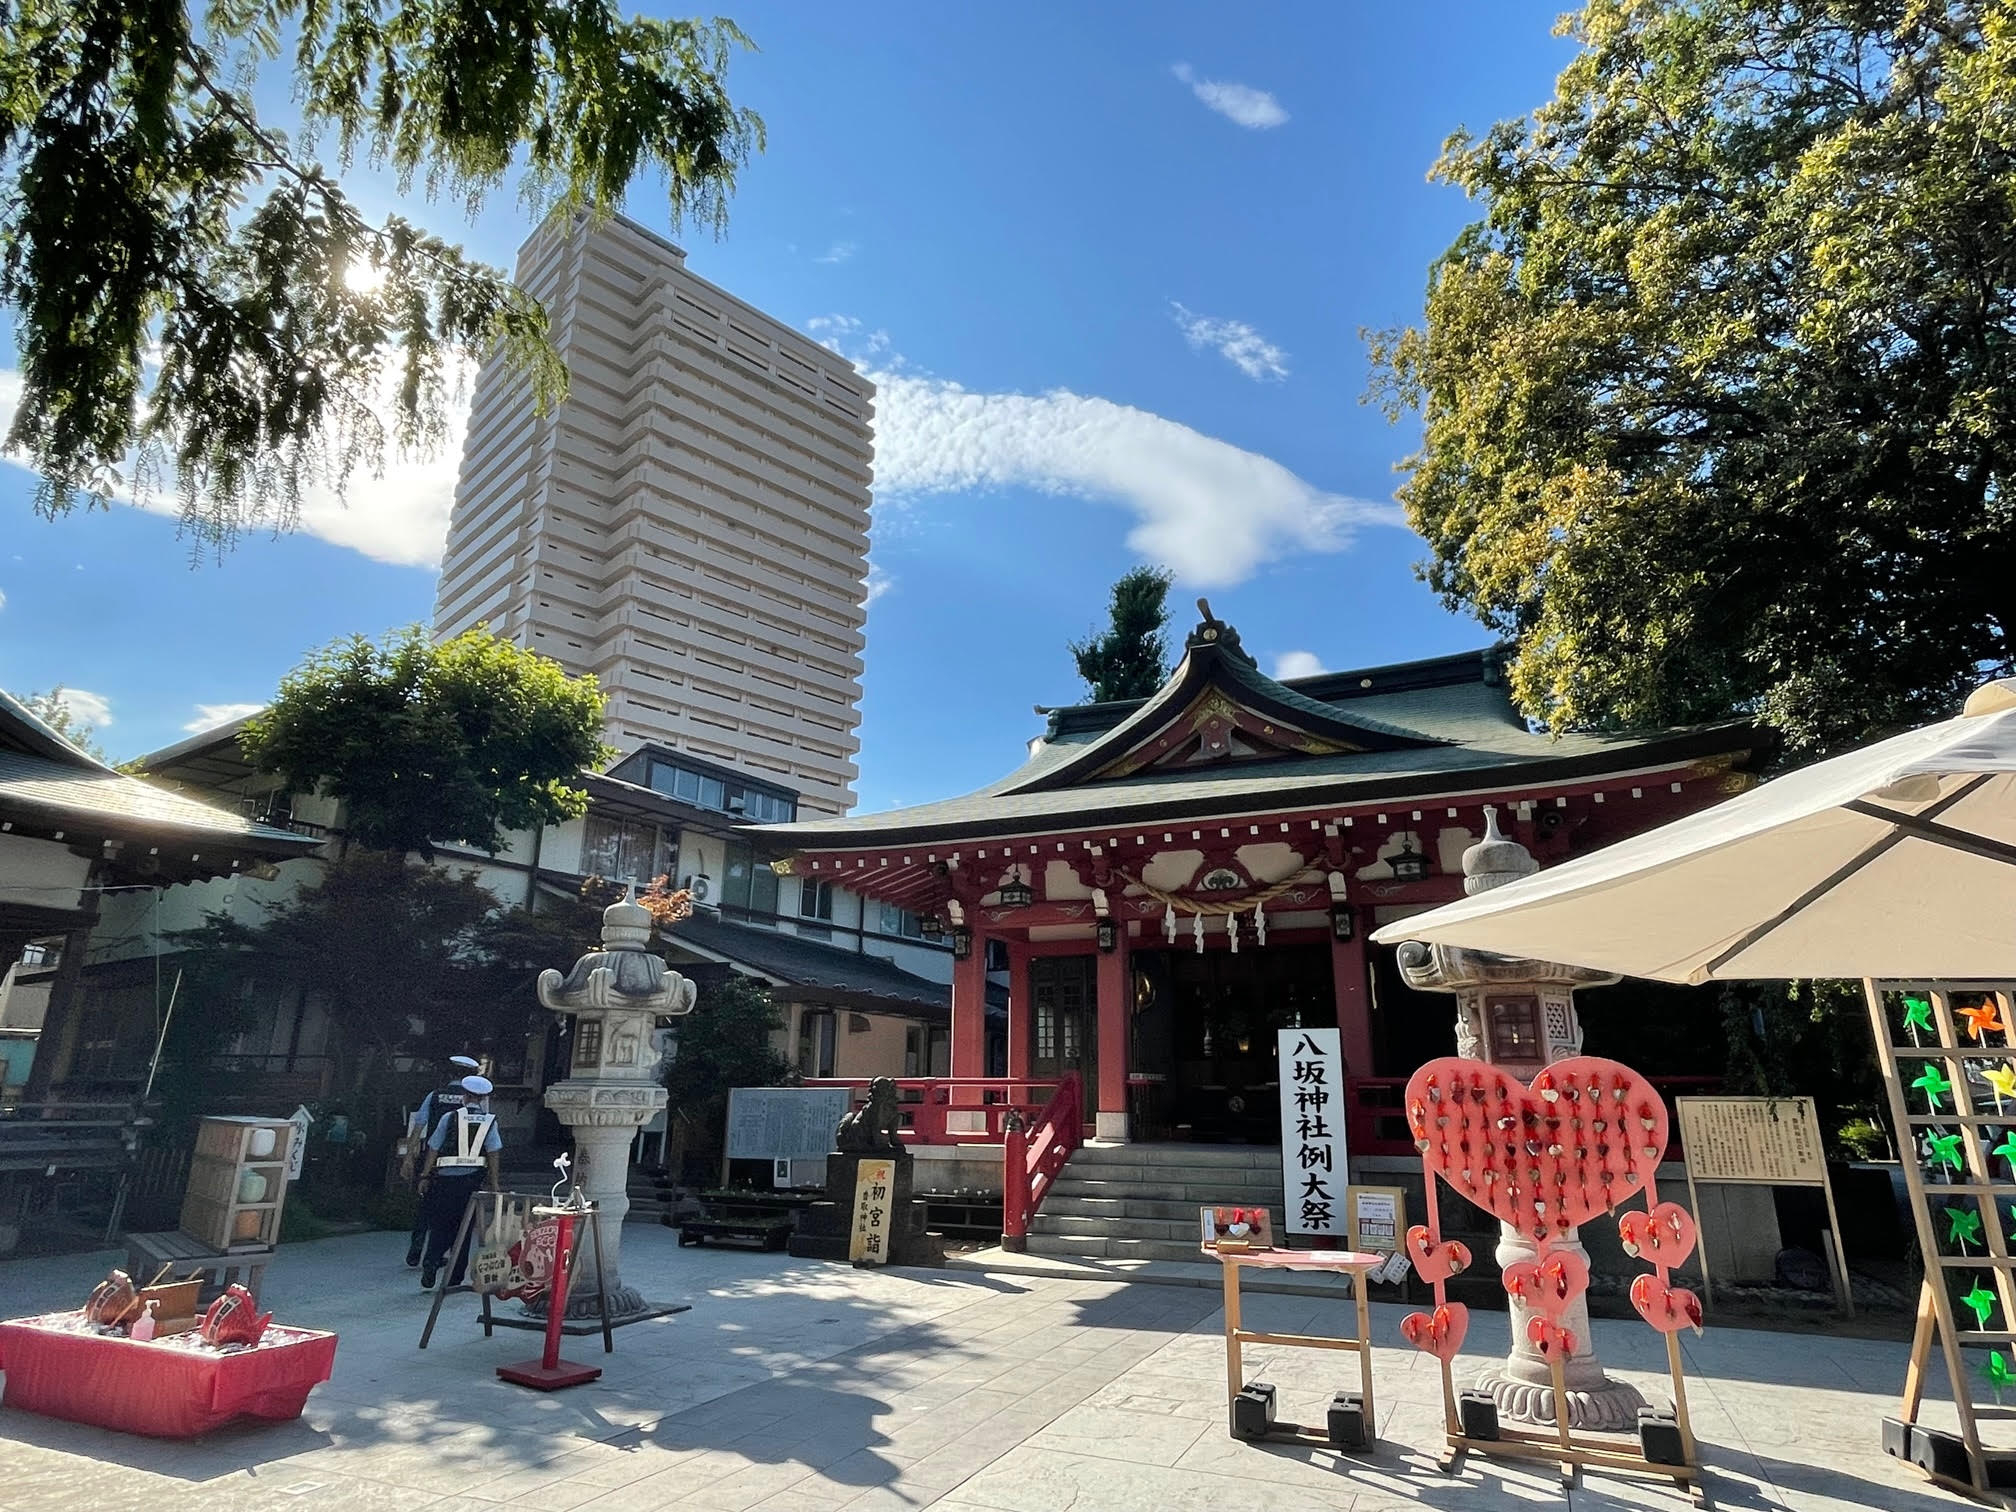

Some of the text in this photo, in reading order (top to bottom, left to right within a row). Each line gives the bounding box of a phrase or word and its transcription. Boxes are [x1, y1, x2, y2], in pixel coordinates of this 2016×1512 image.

[1292, 1033, 1337, 1231] 八坂神社例大祭
[866, 1182, 886, 1255] 初宮詣
